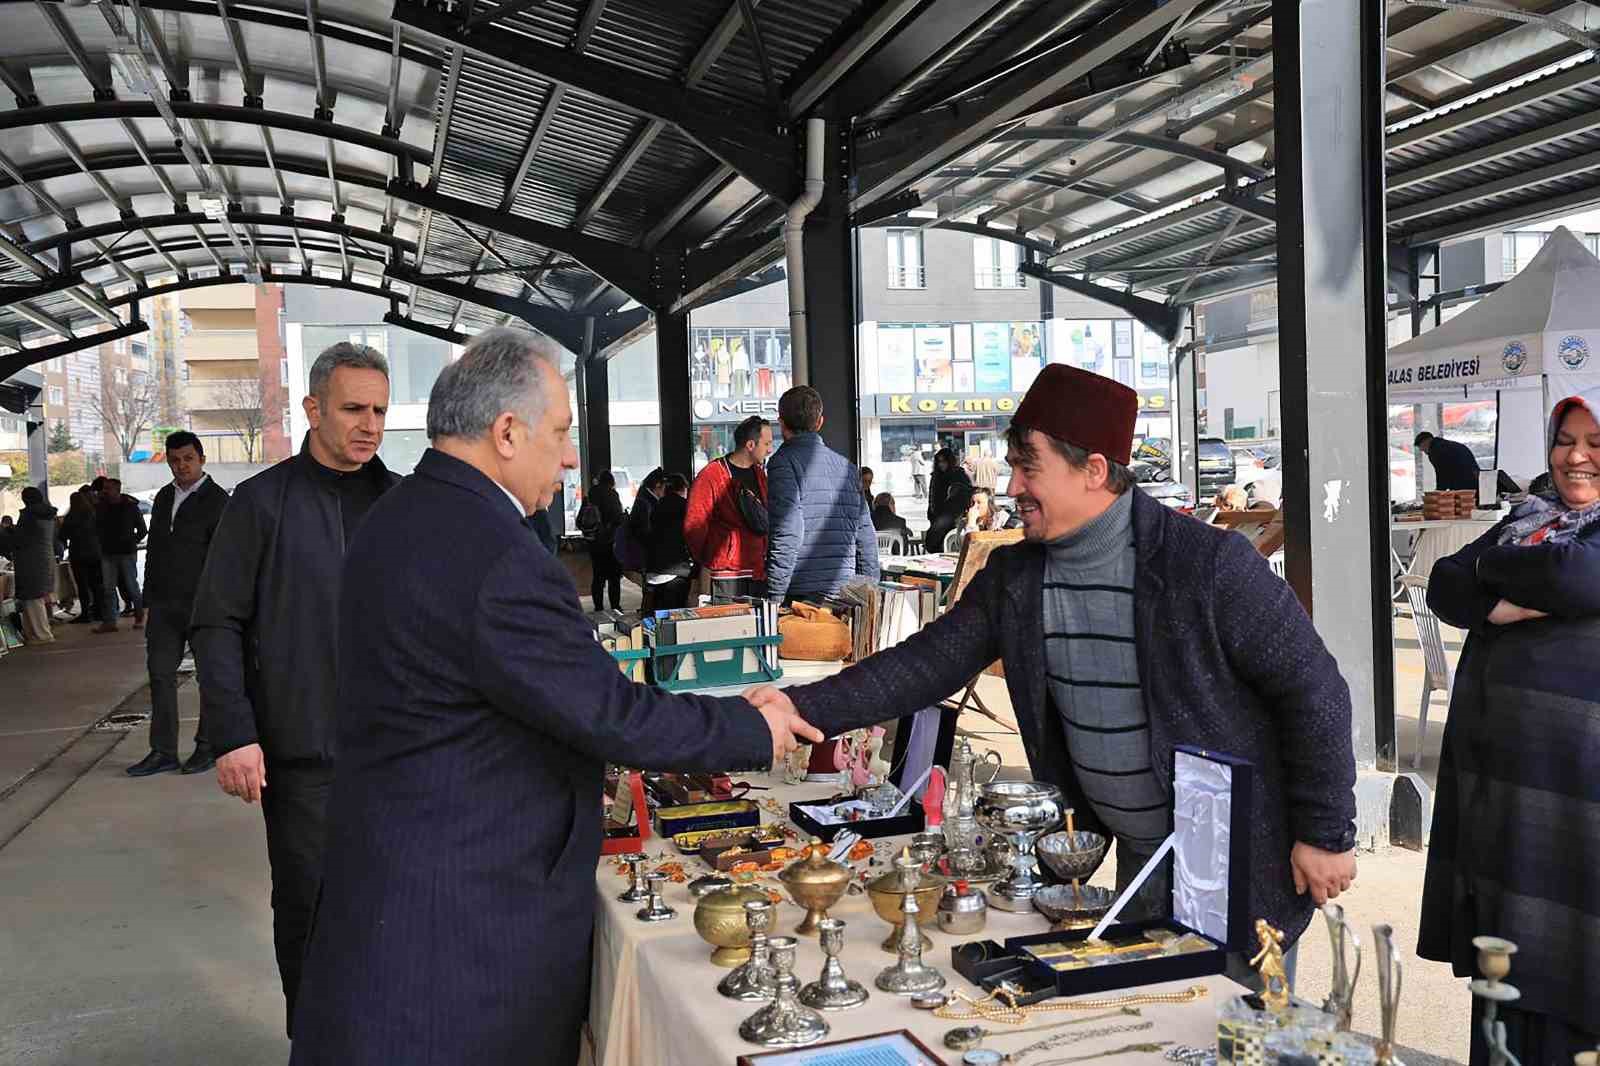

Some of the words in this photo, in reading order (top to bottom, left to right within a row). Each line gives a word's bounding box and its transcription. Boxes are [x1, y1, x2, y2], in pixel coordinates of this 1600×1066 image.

[1387, 367, 1413, 384] ALAS
[1418, 355, 1480, 381] BELEDİYESİ
[890, 394, 1025, 413] Kozme
